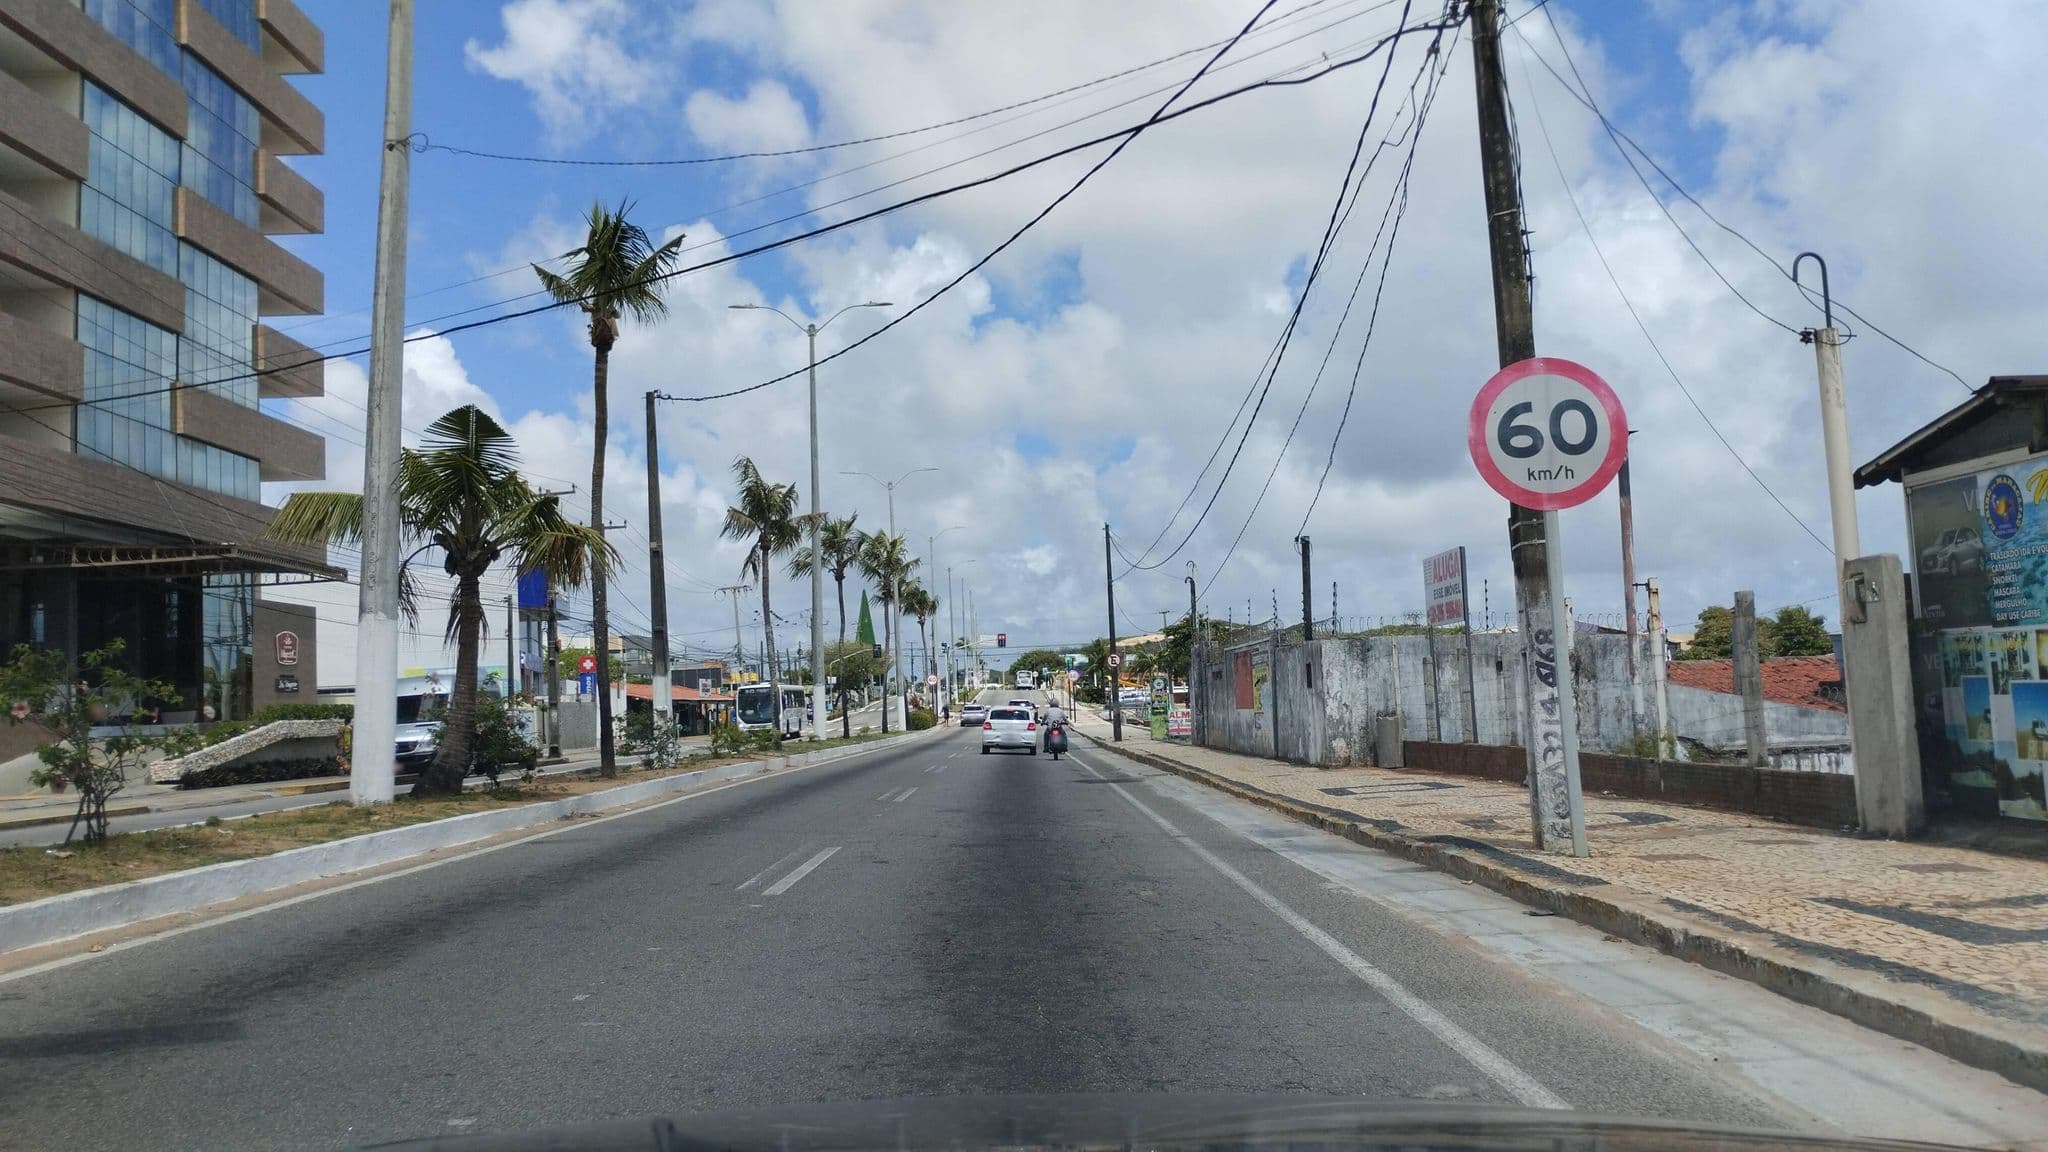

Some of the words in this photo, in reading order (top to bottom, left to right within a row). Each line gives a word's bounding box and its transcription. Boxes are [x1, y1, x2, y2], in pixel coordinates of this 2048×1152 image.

[1497, 398, 1598, 459] 60
[1527, 465, 1574, 481] km/h
[1433, 551, 1460, 583] ALUGA
